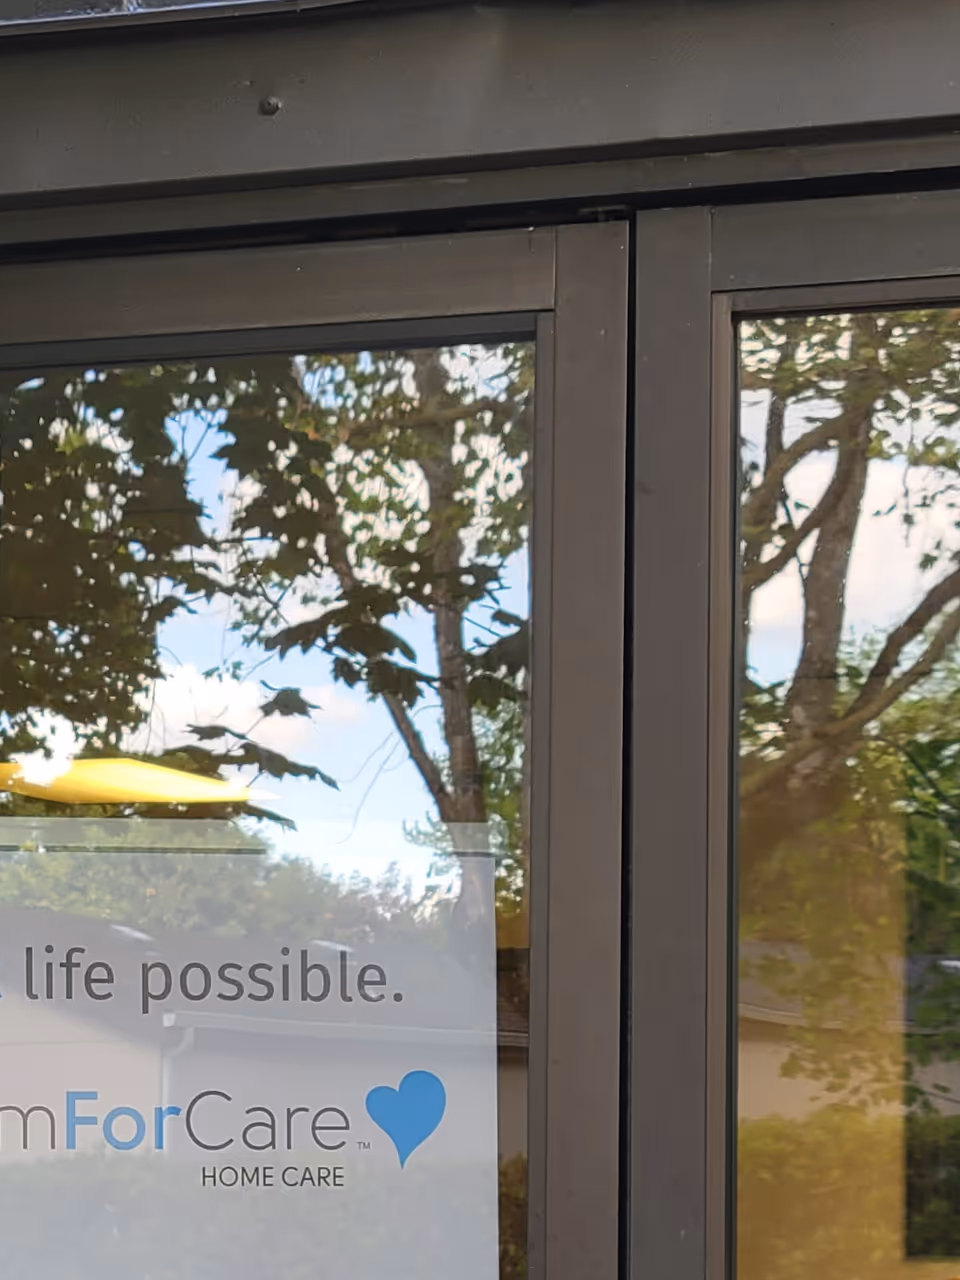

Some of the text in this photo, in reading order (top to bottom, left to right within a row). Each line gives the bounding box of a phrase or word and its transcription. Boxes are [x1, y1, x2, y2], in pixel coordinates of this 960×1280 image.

[24, 944, 116, 1002] life
[141, 947, 404, 1015] possible.
[201, 1166, 345, 1187] HOME CARE
